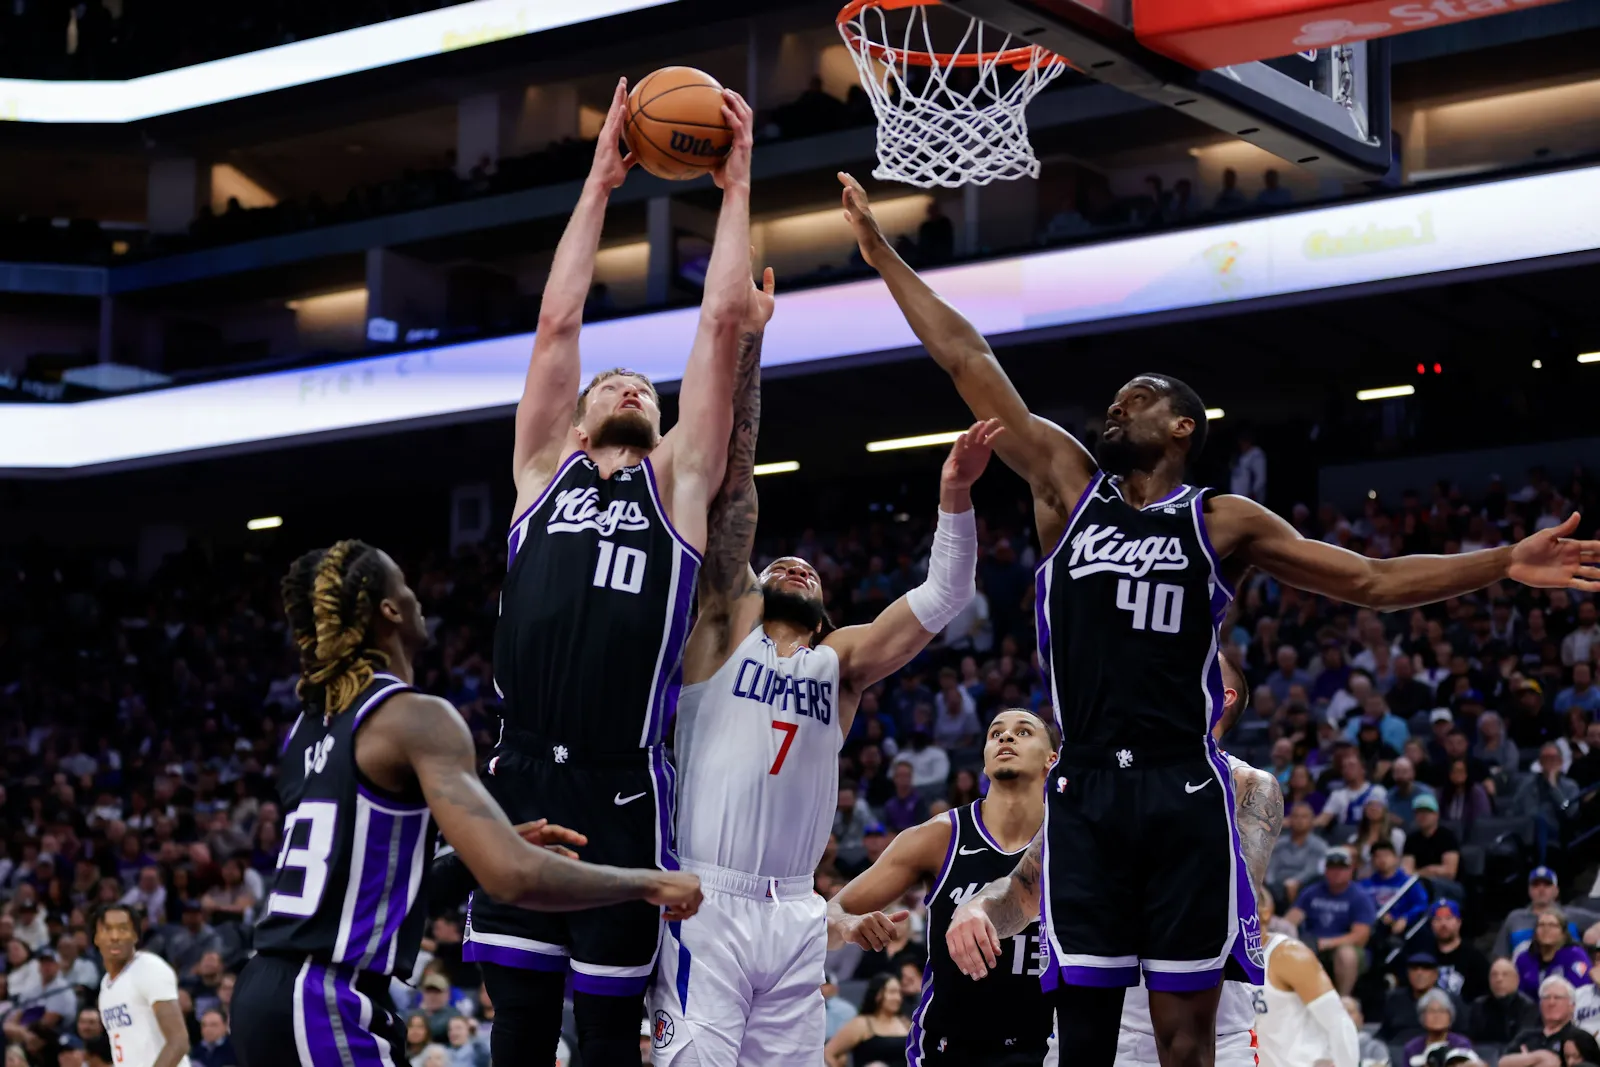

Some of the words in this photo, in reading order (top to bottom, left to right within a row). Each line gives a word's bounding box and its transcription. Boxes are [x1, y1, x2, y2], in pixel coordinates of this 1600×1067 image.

[1389, 0, 1536, 26] Sta
[670, 129, 731, 157] Wil
[593, 540, 647, 594] 10
[1068, 524, 1189, 580] Kings
[1116, 579, 1184, 633] 40
[733, 658, 832, 725] CLIPPERS
[769, 720, 799, 775] 7
[114, 1033, 124, 1063] 5
